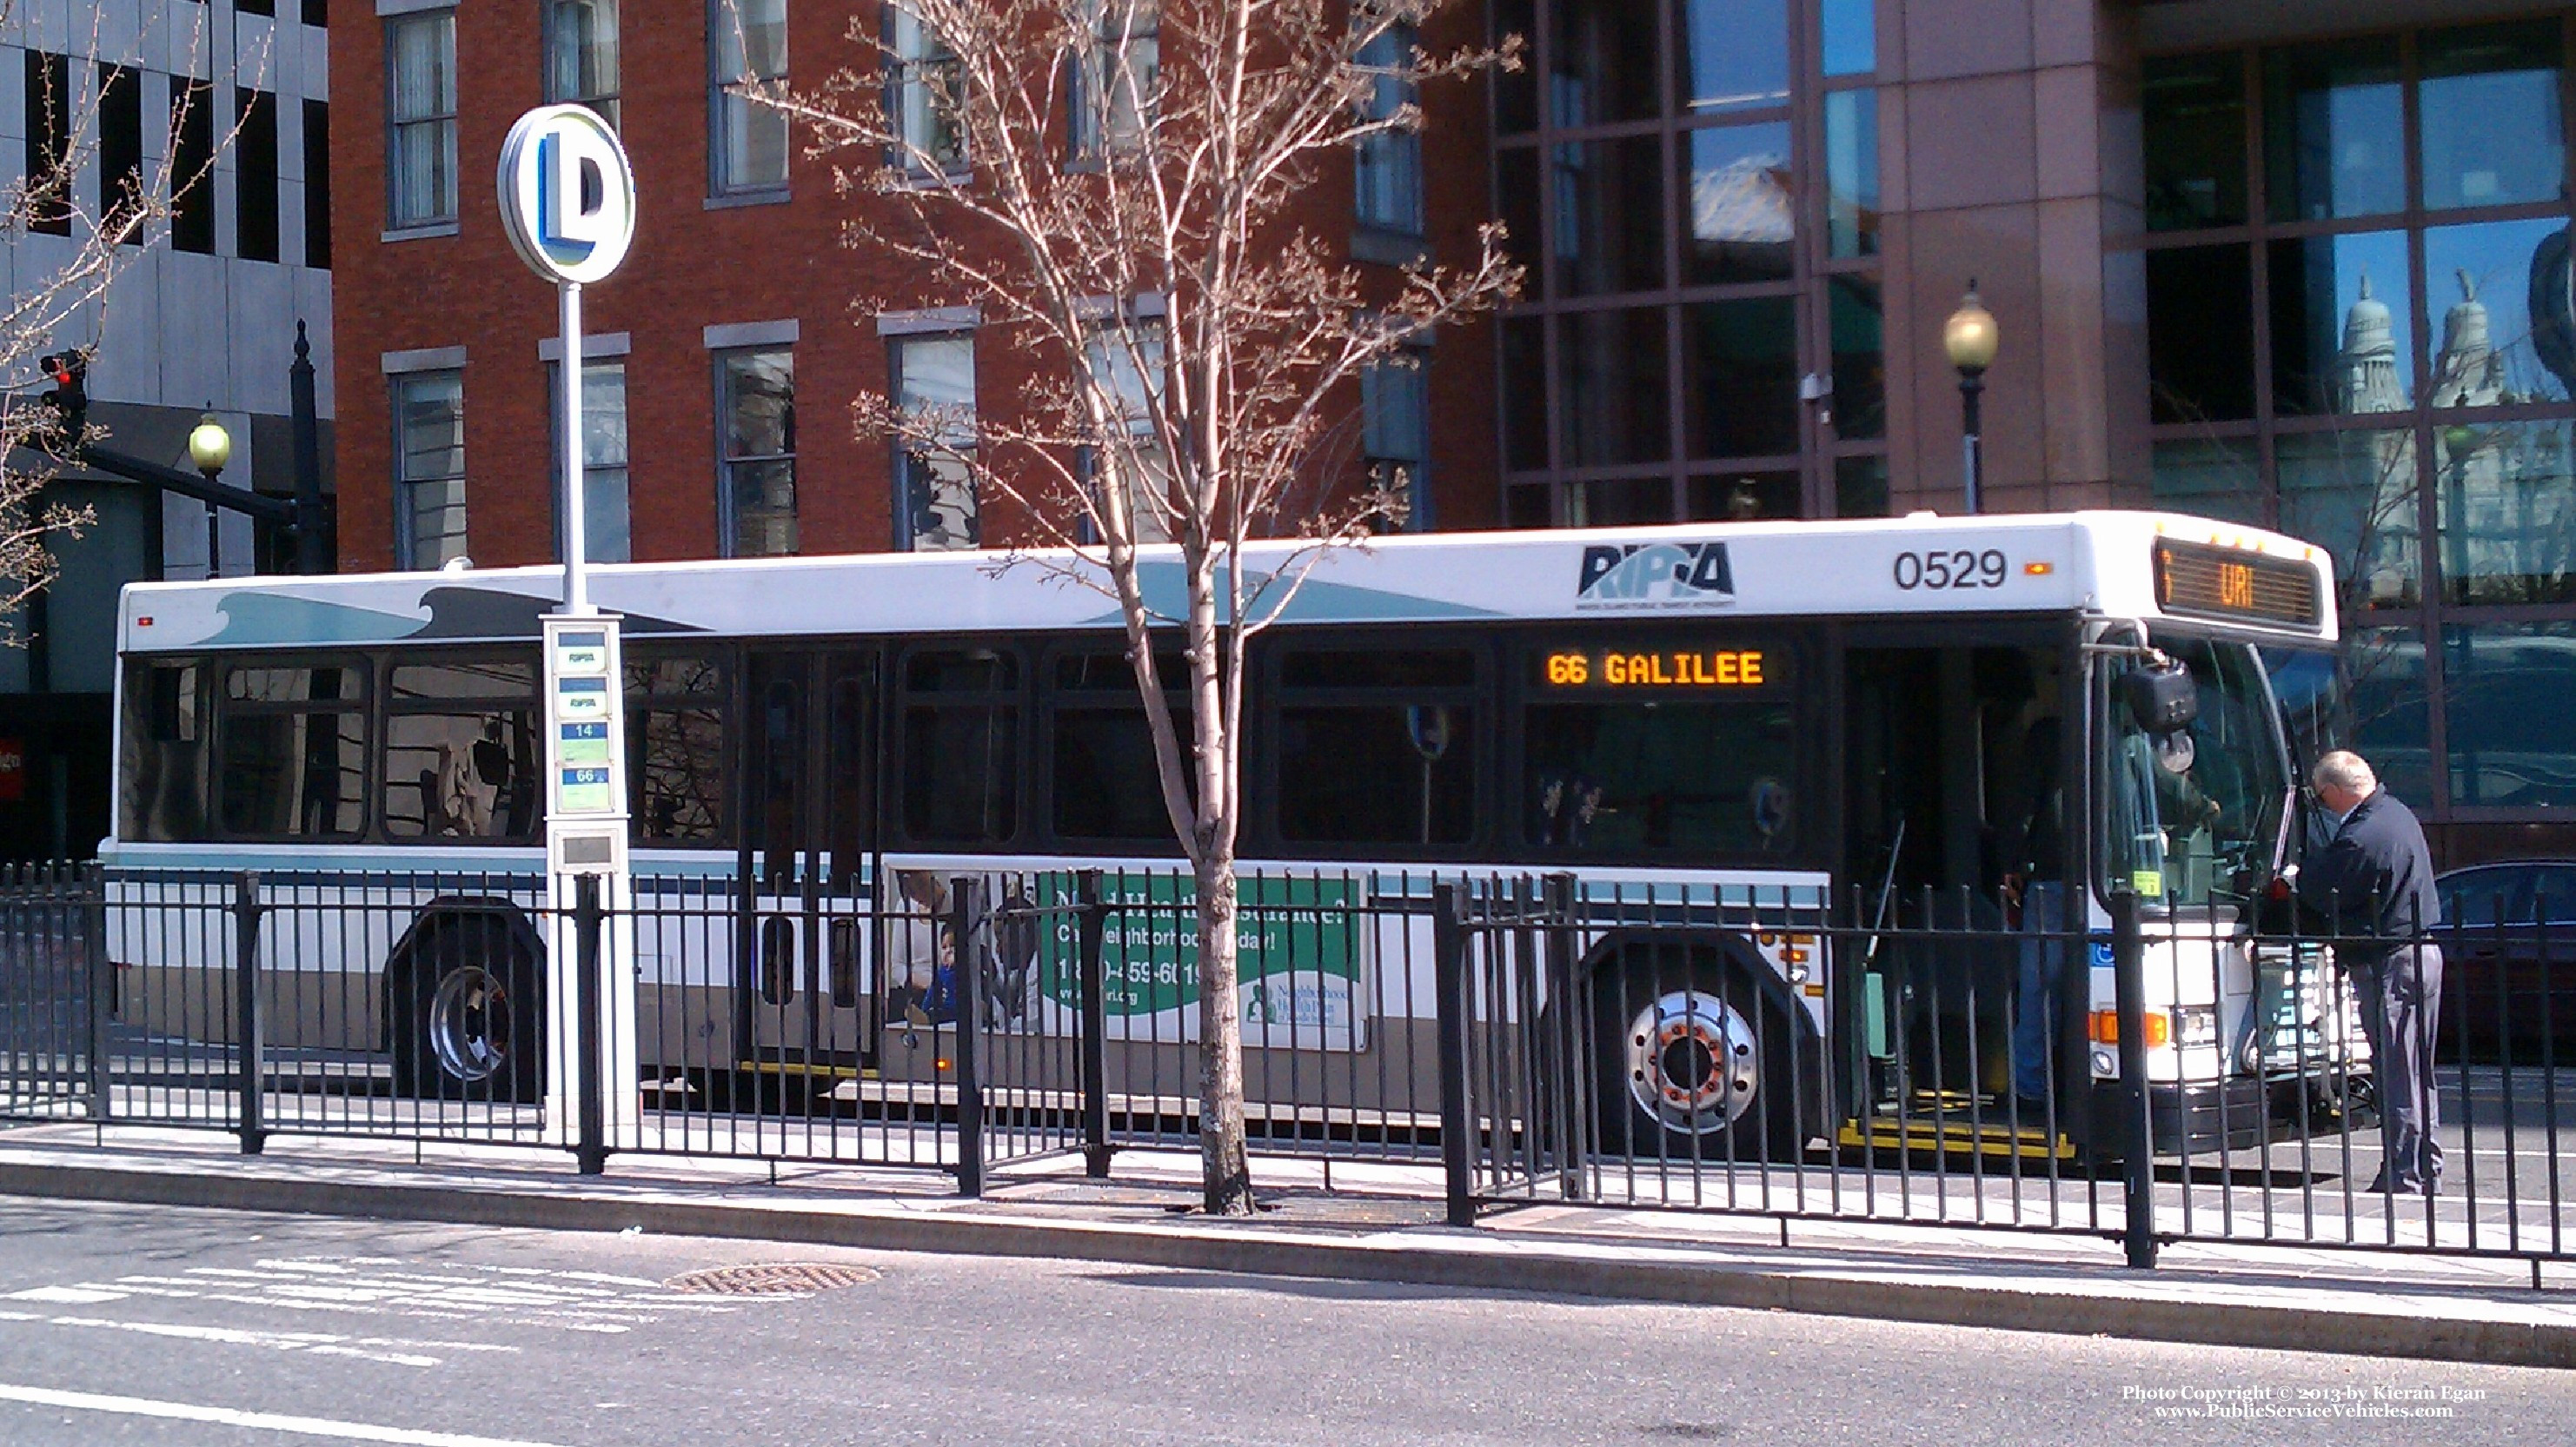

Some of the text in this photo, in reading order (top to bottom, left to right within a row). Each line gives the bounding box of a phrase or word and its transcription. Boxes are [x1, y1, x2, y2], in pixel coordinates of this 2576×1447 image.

[547, 131, 623, 242] D
[1894, 548, 2007, 590] 0529
[1550, 653, 1763, 684] 66 GALILEE
[576, 724, 593, 737] 14
[576, 769, 594, 782] 66
